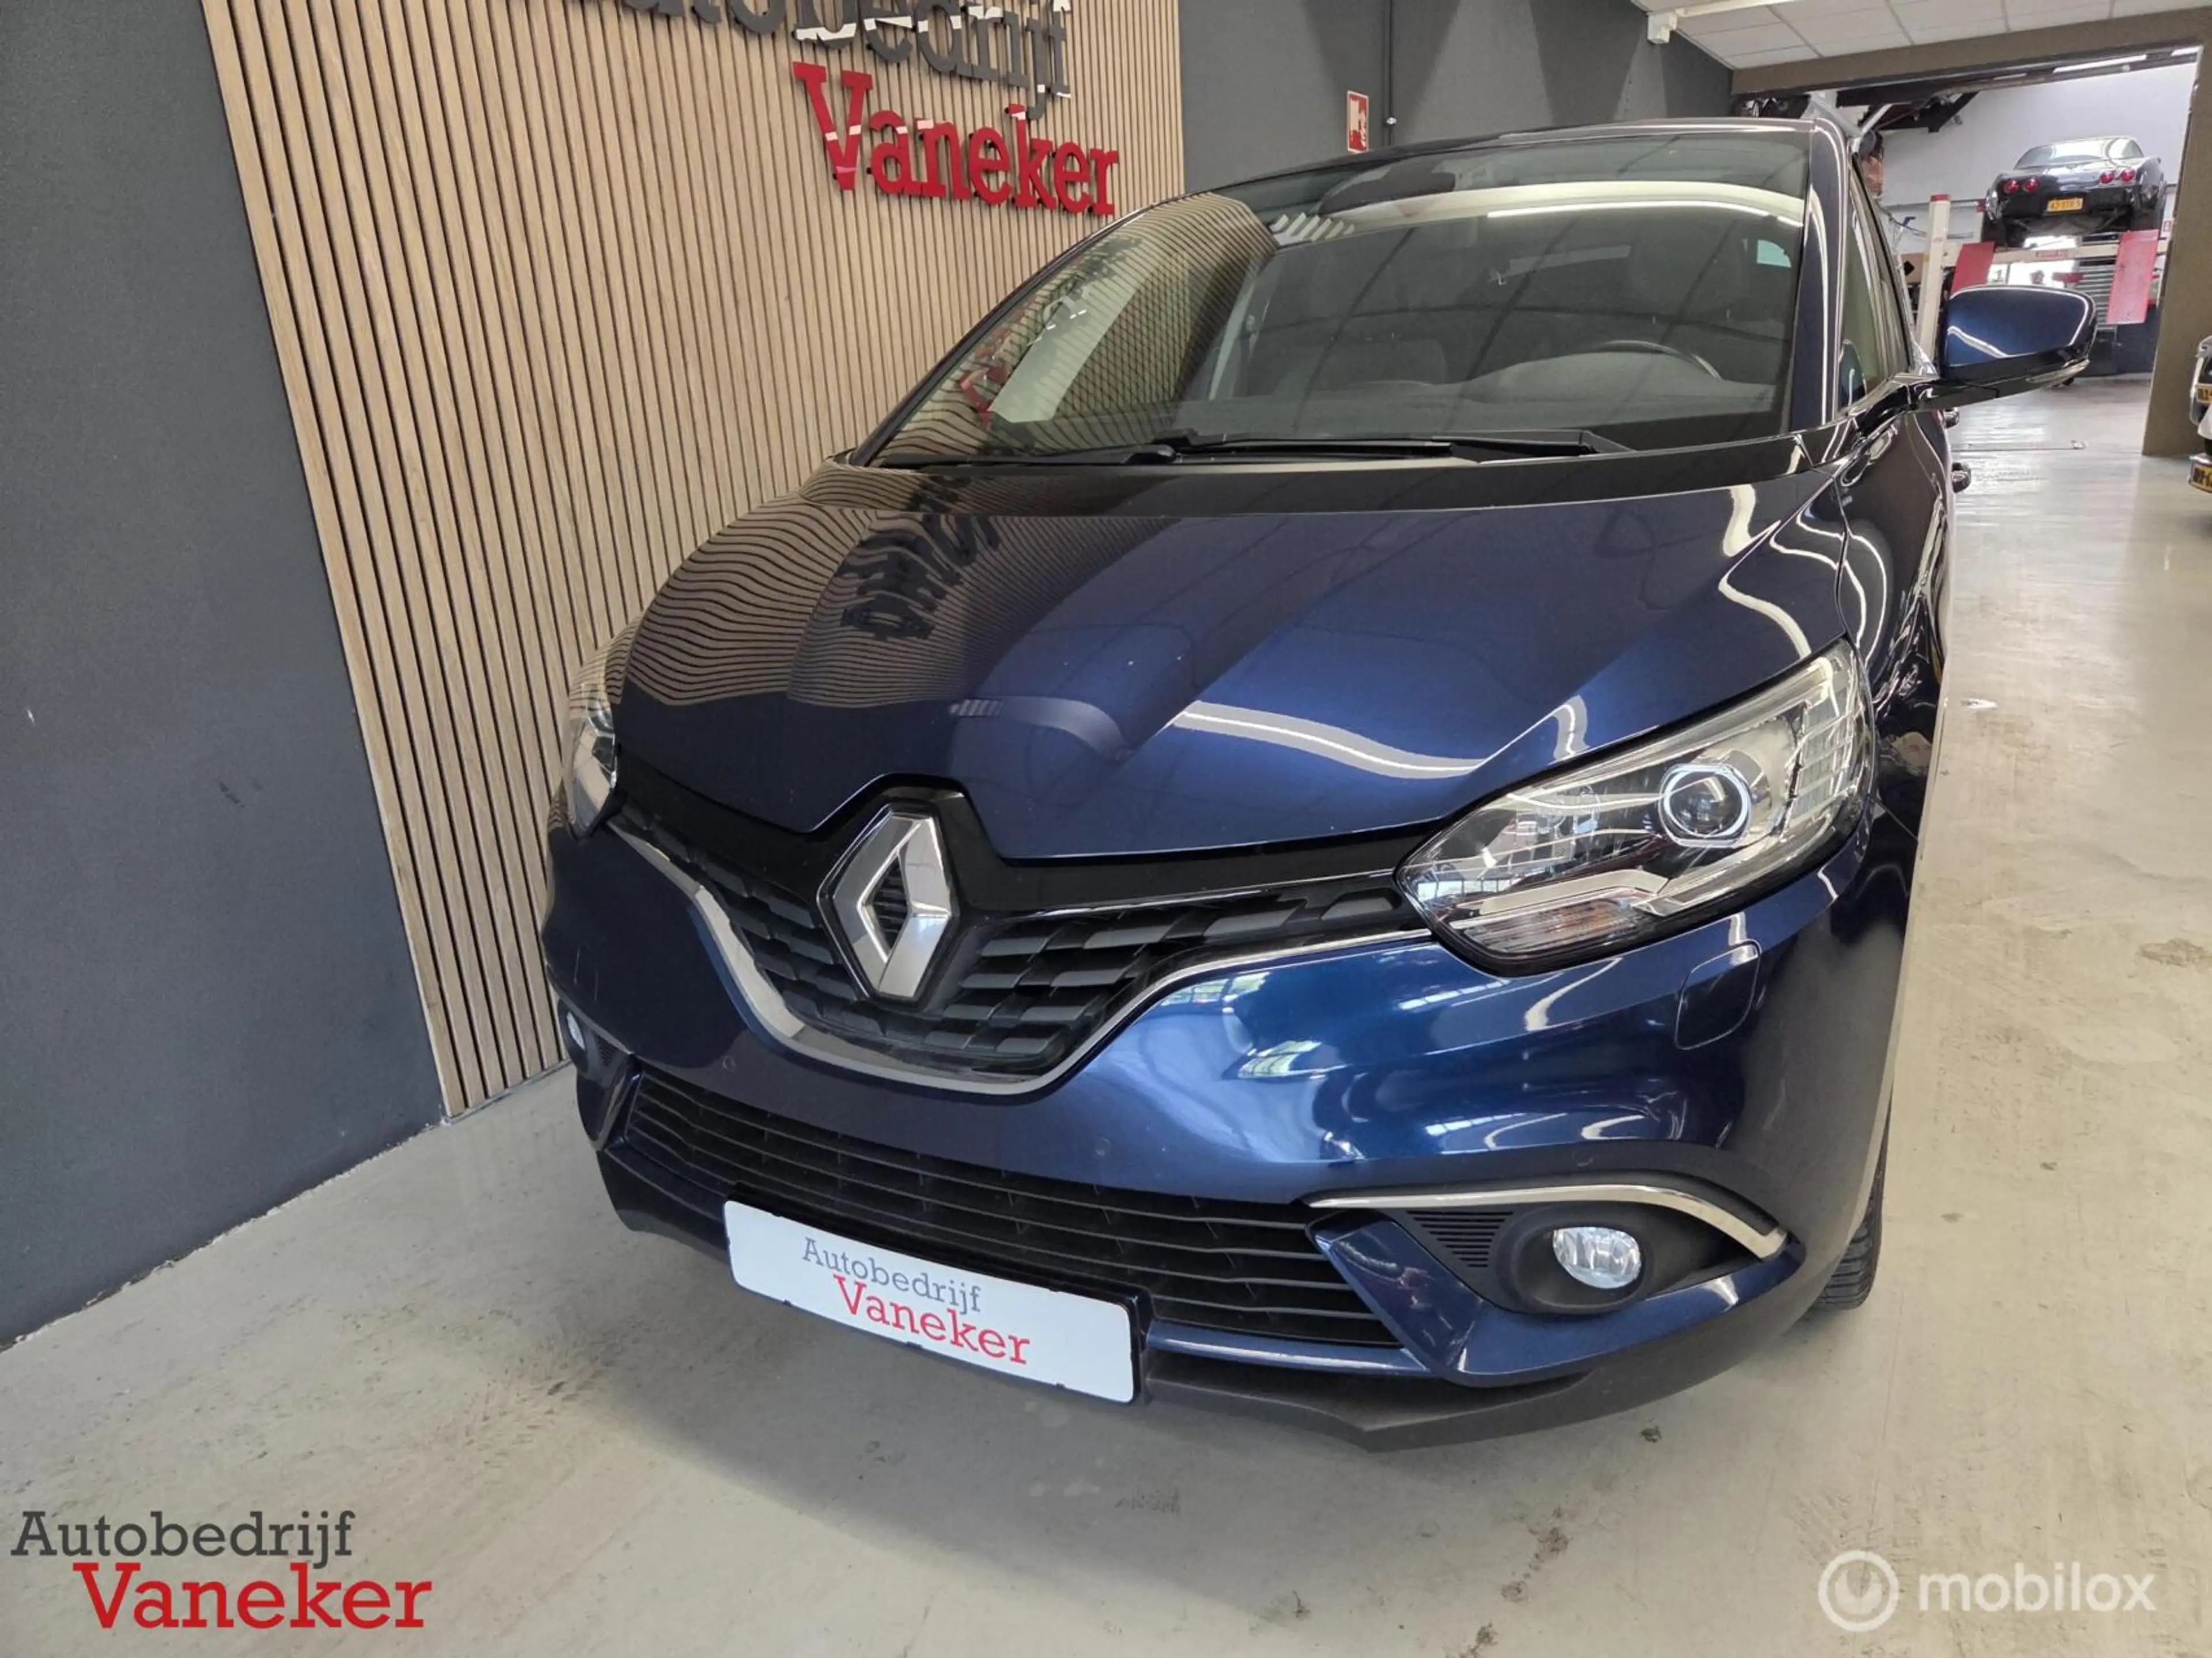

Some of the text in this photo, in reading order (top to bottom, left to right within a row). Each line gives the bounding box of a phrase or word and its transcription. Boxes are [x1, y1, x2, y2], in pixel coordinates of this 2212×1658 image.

[793, 61, 1118, 217] Vaneker
[802, 1237, 982, 1315] Autobedrijf
[833, 1273, 1030, 1365] Vaneker
